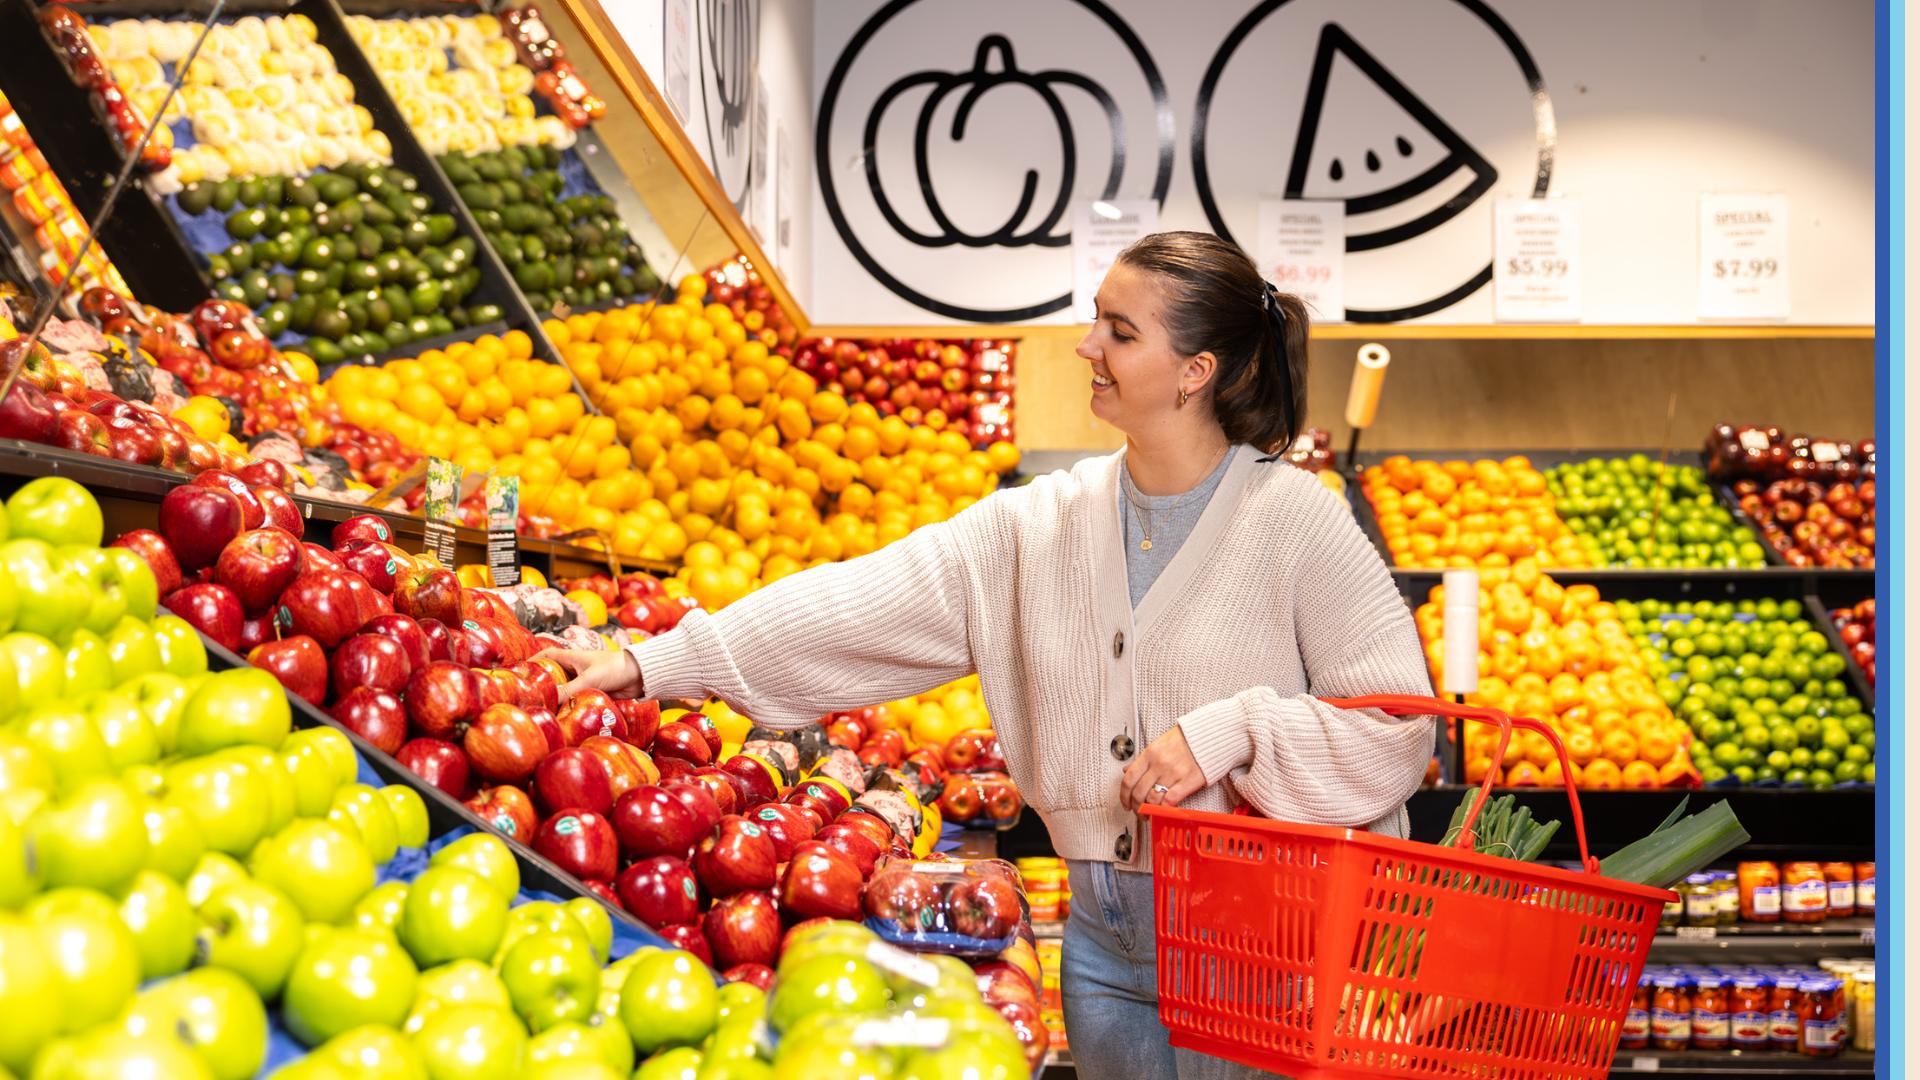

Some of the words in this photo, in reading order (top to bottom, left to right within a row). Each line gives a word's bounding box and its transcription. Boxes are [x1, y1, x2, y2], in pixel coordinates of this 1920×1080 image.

[1714, 210, 1774, 225] SPECIAL
[1275, 265, 1332, 284] $6.99
[1507, 257, 1569, 279] $5.99
[1713, 258, 1779, 280] $7.99
